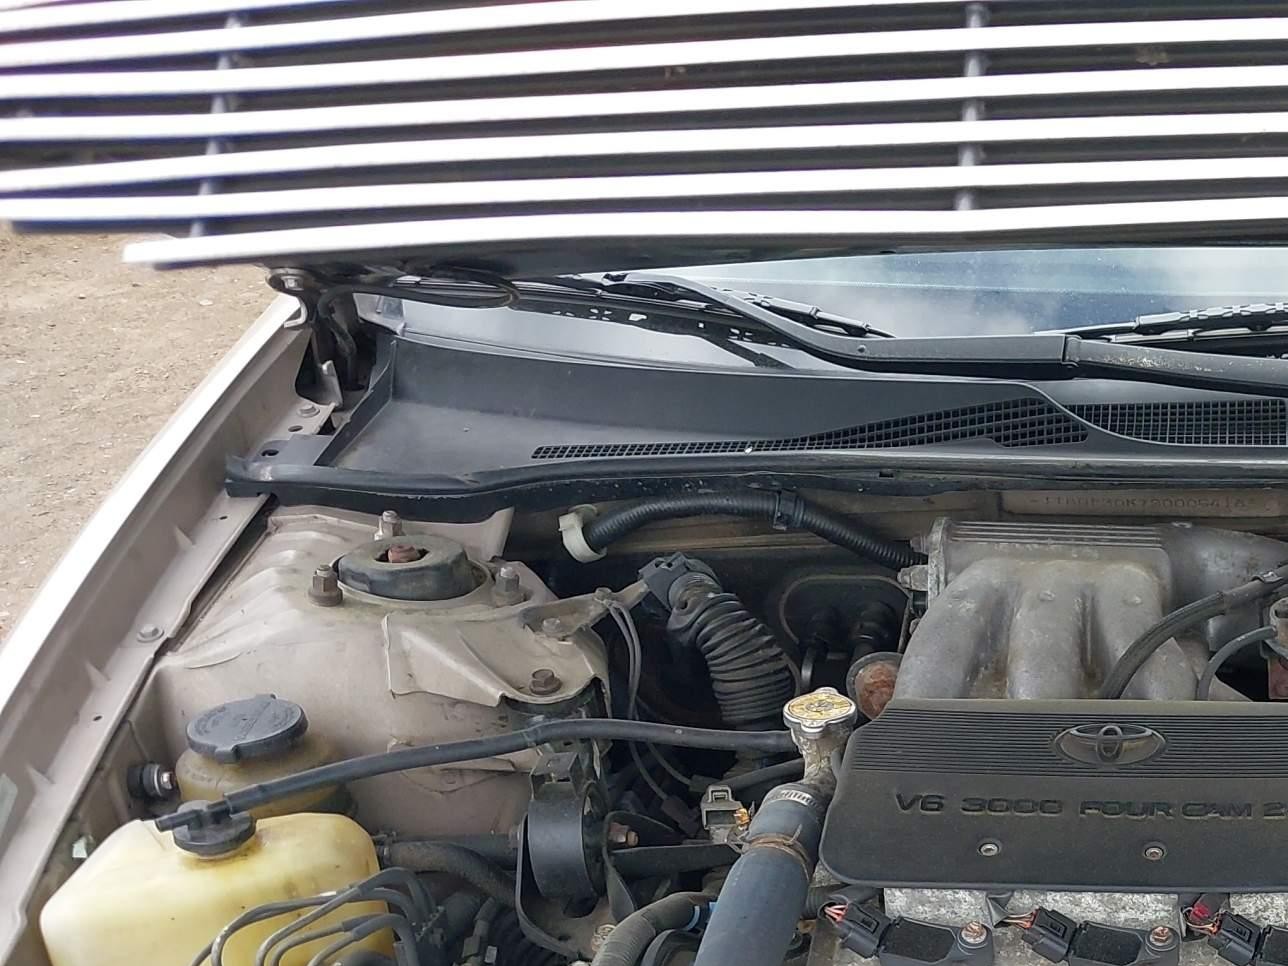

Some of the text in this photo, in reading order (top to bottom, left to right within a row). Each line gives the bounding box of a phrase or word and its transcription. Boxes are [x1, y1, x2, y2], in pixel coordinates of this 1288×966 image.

[895, 793, 945, 812] V6
[960, 797, 1064, 815] 3000
[1079, 799, 1174, 819] FOUR
[1181, 801, 1253, 819] CAM
